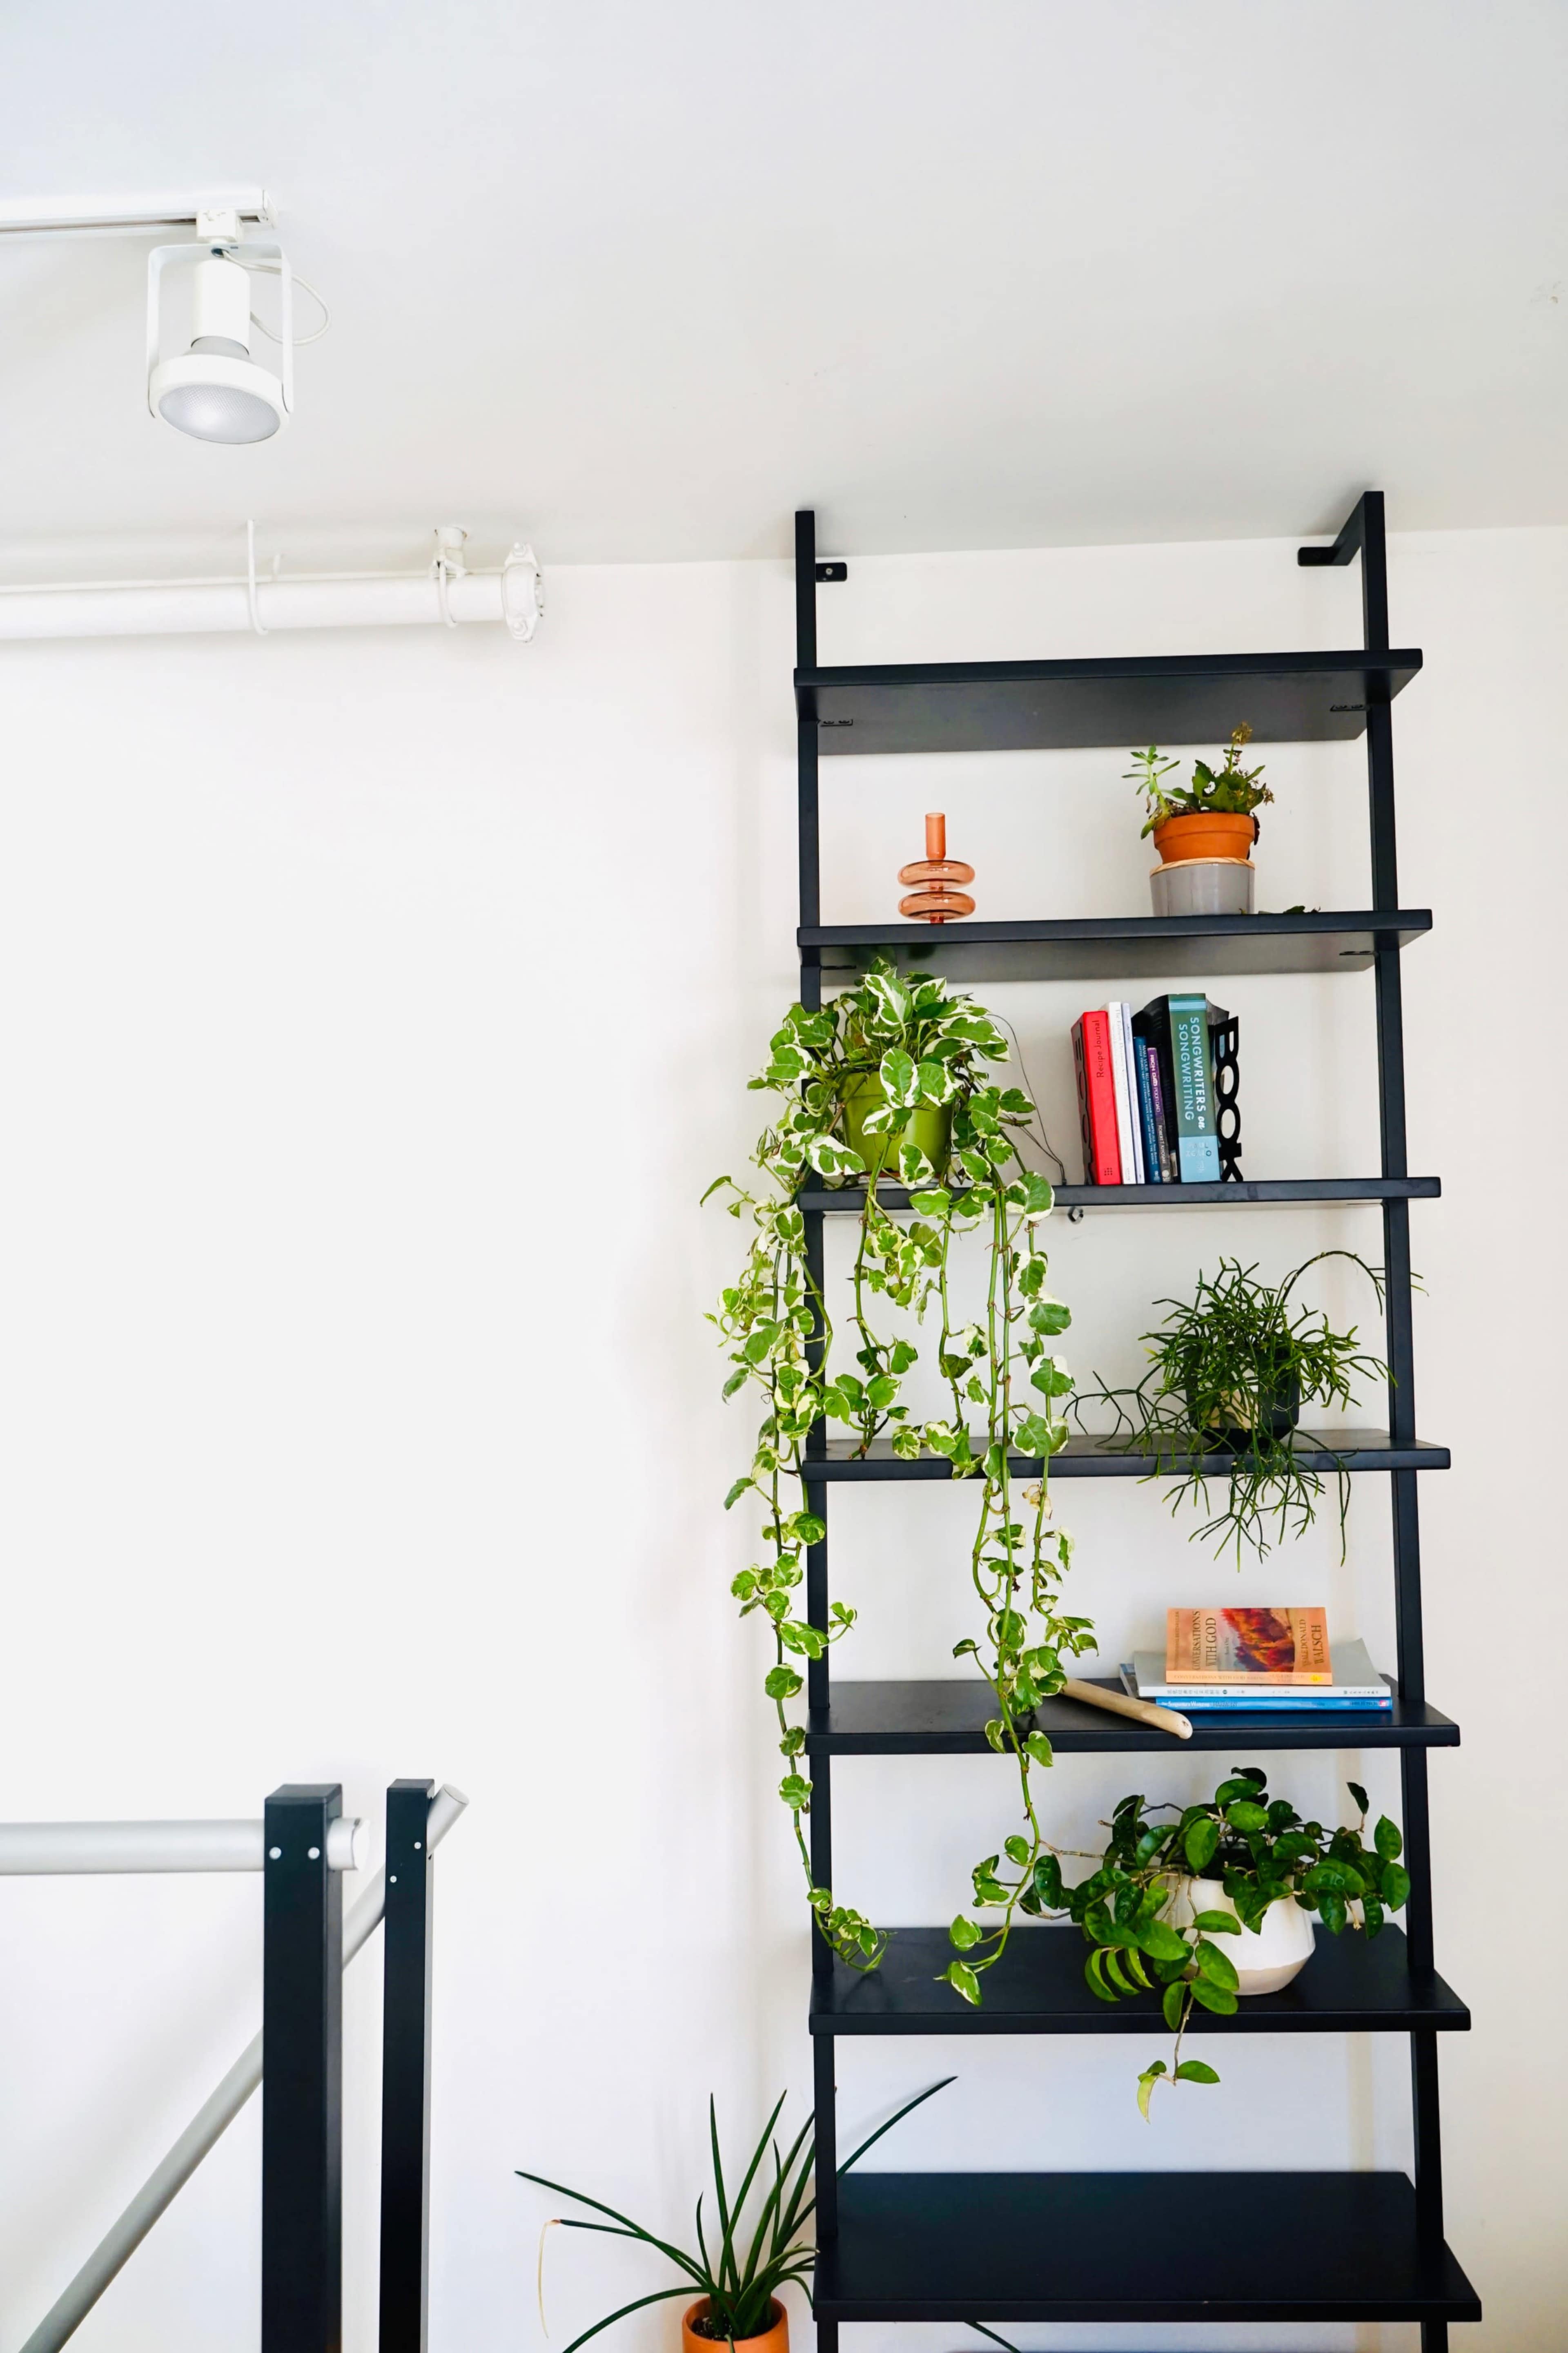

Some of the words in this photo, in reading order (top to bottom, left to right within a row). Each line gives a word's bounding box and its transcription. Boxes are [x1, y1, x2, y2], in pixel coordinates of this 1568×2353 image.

[1092, 1020, 1101, 1048] Journal
[1178, 1024, 1194, 1121] SONGWRITING
[1190, 1017, 1206, 1112] SONGWRITERS
[1198, 1115, 1206, 1130] on
[1214, 1016, 1244, 1182] BOOK
[1192, 1611, 1201, 1670] CONVERSATIONS
[1205, 1617, 1217, 1643] GOD
[1299, 1619, 1308, 1649] DONALD
[1205, 1646, 1217, 1666] WITH
